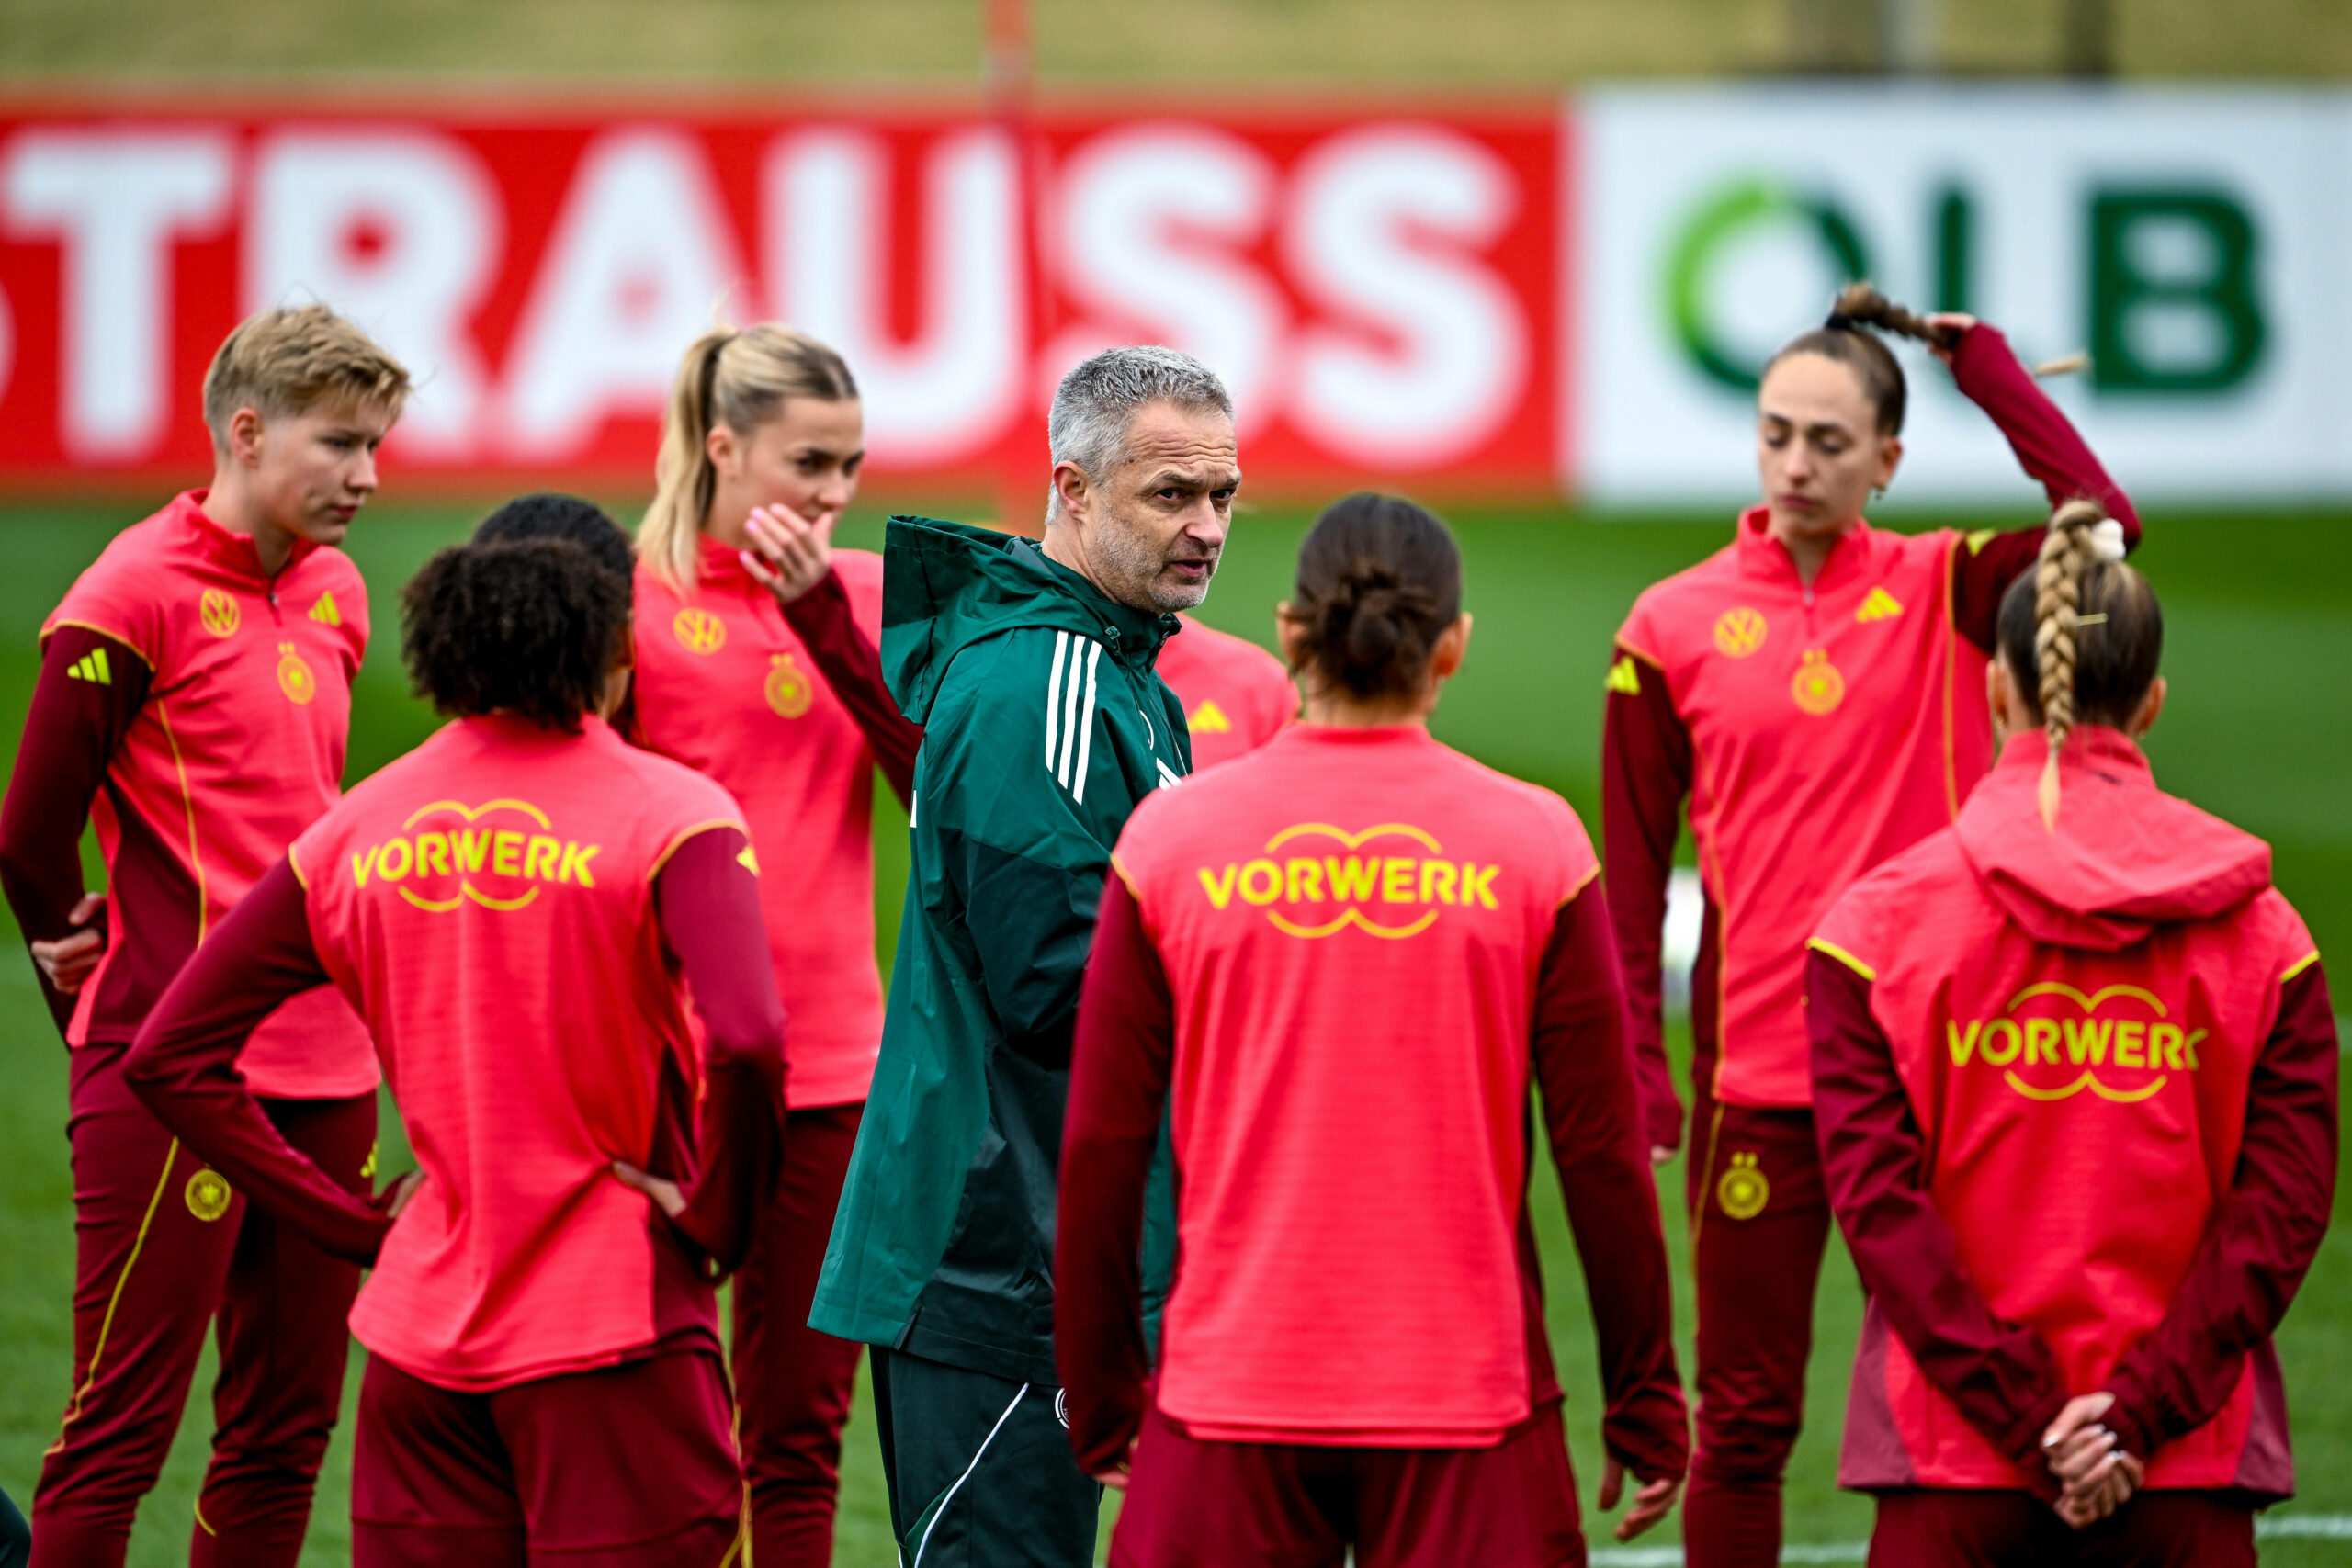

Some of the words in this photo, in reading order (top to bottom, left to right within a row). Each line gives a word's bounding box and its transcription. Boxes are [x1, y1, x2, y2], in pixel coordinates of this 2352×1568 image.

[0, 119, 1529, 474] TRAUSS
[351, 828, 600, 888] VORWERK
[1197, 855, 1501, 910] VORWERK
